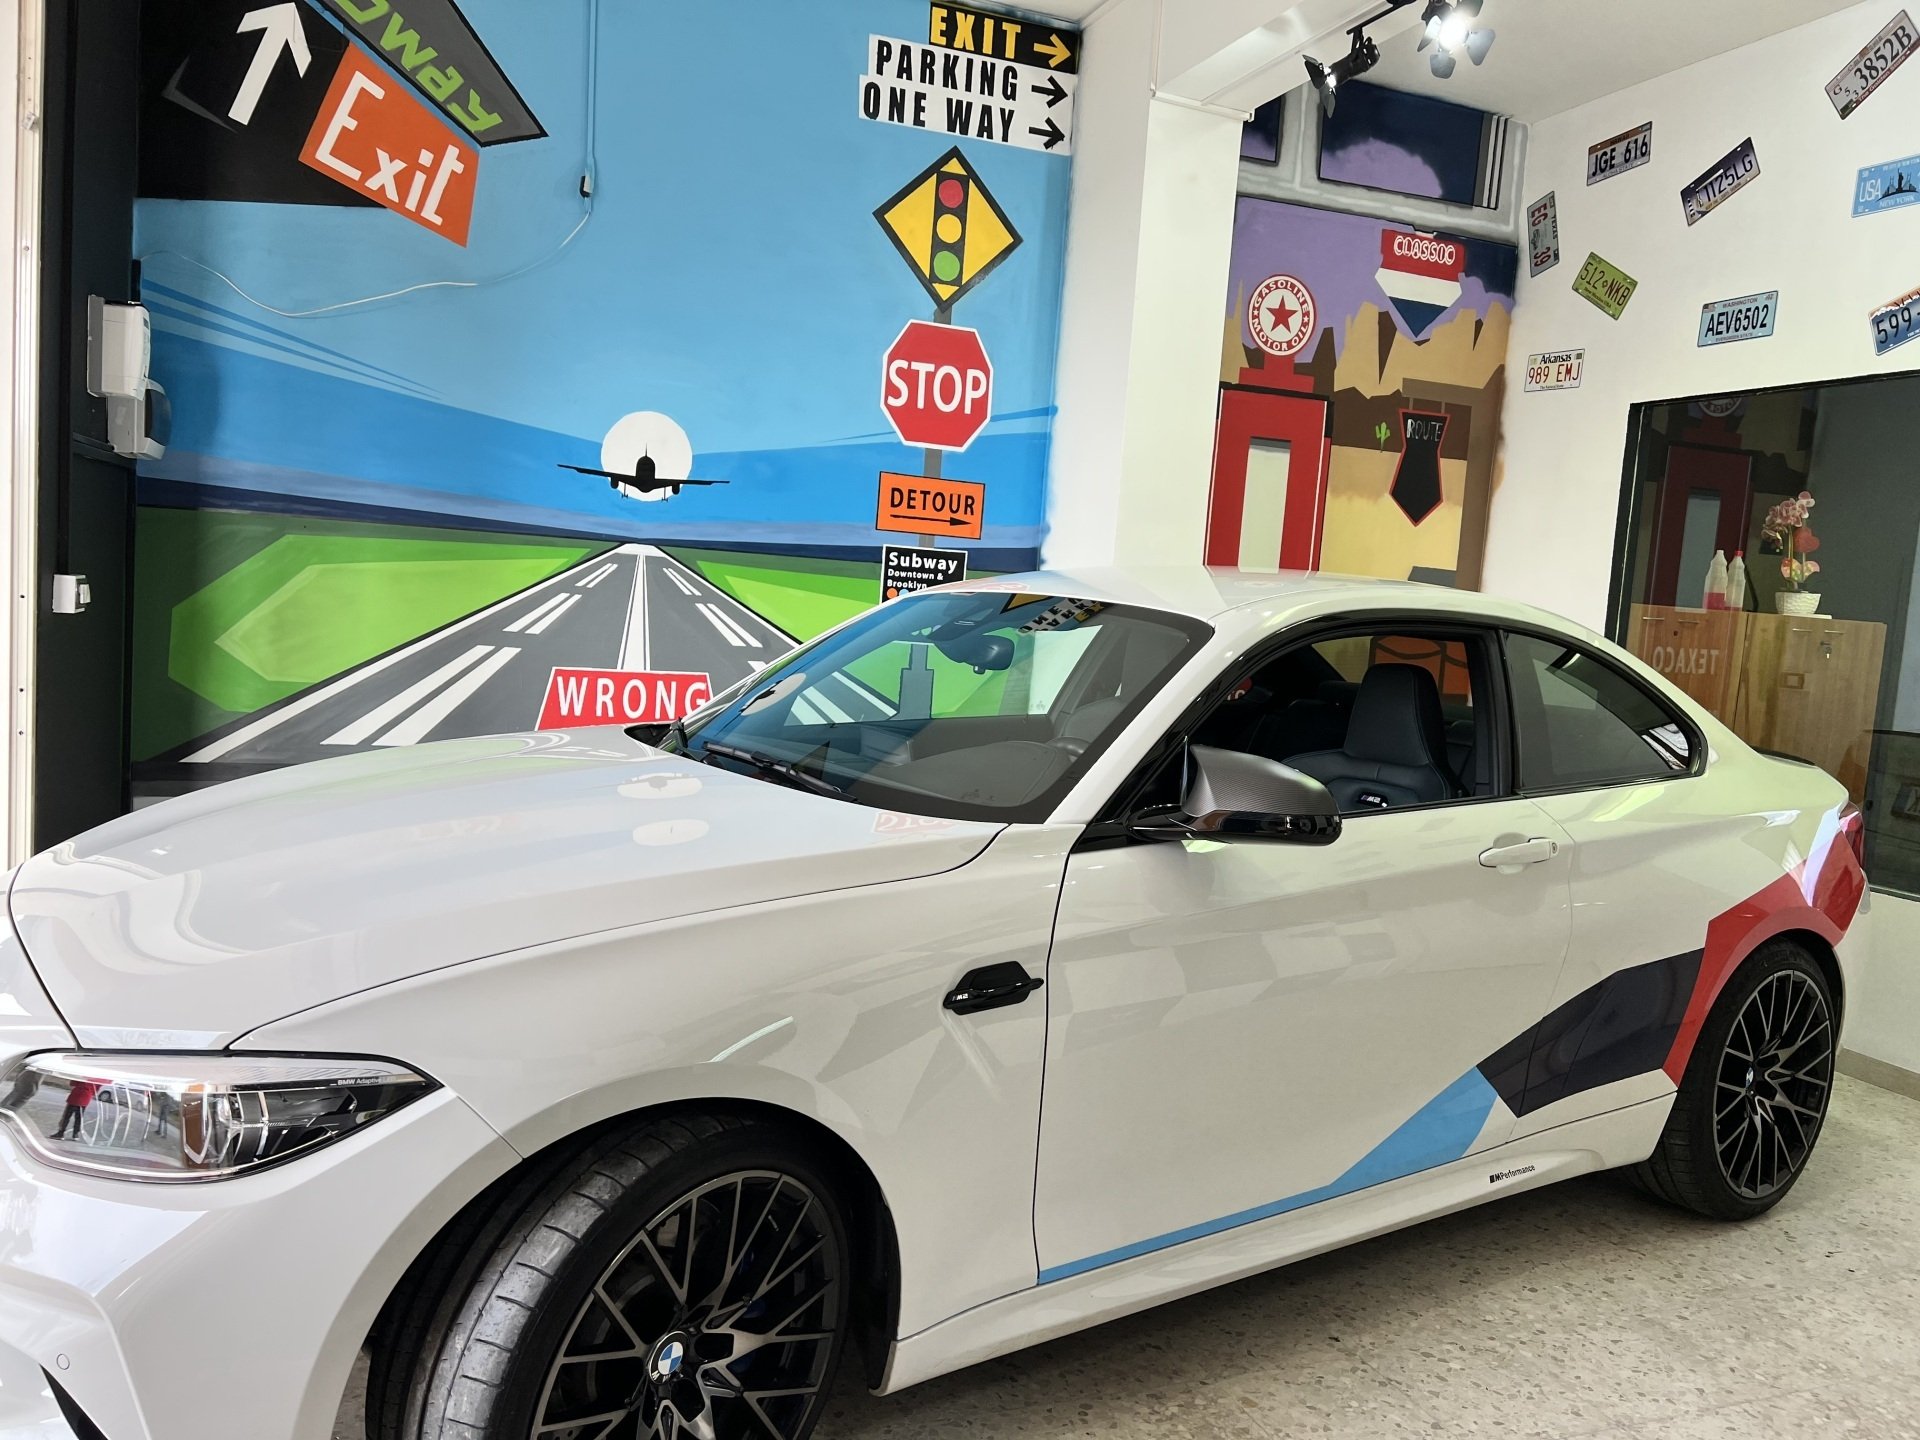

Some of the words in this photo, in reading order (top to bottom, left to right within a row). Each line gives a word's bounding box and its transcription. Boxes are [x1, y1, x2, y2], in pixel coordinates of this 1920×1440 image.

[930, 6, 1022, 60] EXIT
[876, 39, 1019, 101] PARKING
[1853, 25, 1913, 91] 3852B
[863, 81, 927, 128] ONE
[946, 97, 1015, 143] WAY
[315, 70, 465, 226] Exit
[1591, 146, 1617, 177] JGE
[1623, 134, 1649, 164] 616
[1859, 178, 1881, 203] USA
[1393, 235, 1456, 265] CLASSIC
[1254, 279, 1310, 314] GASOLINE
[1252, 318, 1289, 351] MOTOR
[1291, 325, 1308, 346] OIL
[1704, 303, 1769, 338] AEV6502
[1528, 365, 1550, 385] 989
[1556, 361, 1581, 382] EMJ
[1539, 353, 1572, 365] Arkansas
[887, 359, 987, 415] STOP
[1406, 418, 1444, 442] ROUTE
[890, 487, 976, 516] DETOUR
[887, 568, 935, 580] Downtown
[936, 572, 944, 581] &
[888, 551, 958, 575] Subway
[886, 579, 928, 591] Brooklyn
[556, 675, 707, 720] WRONG
